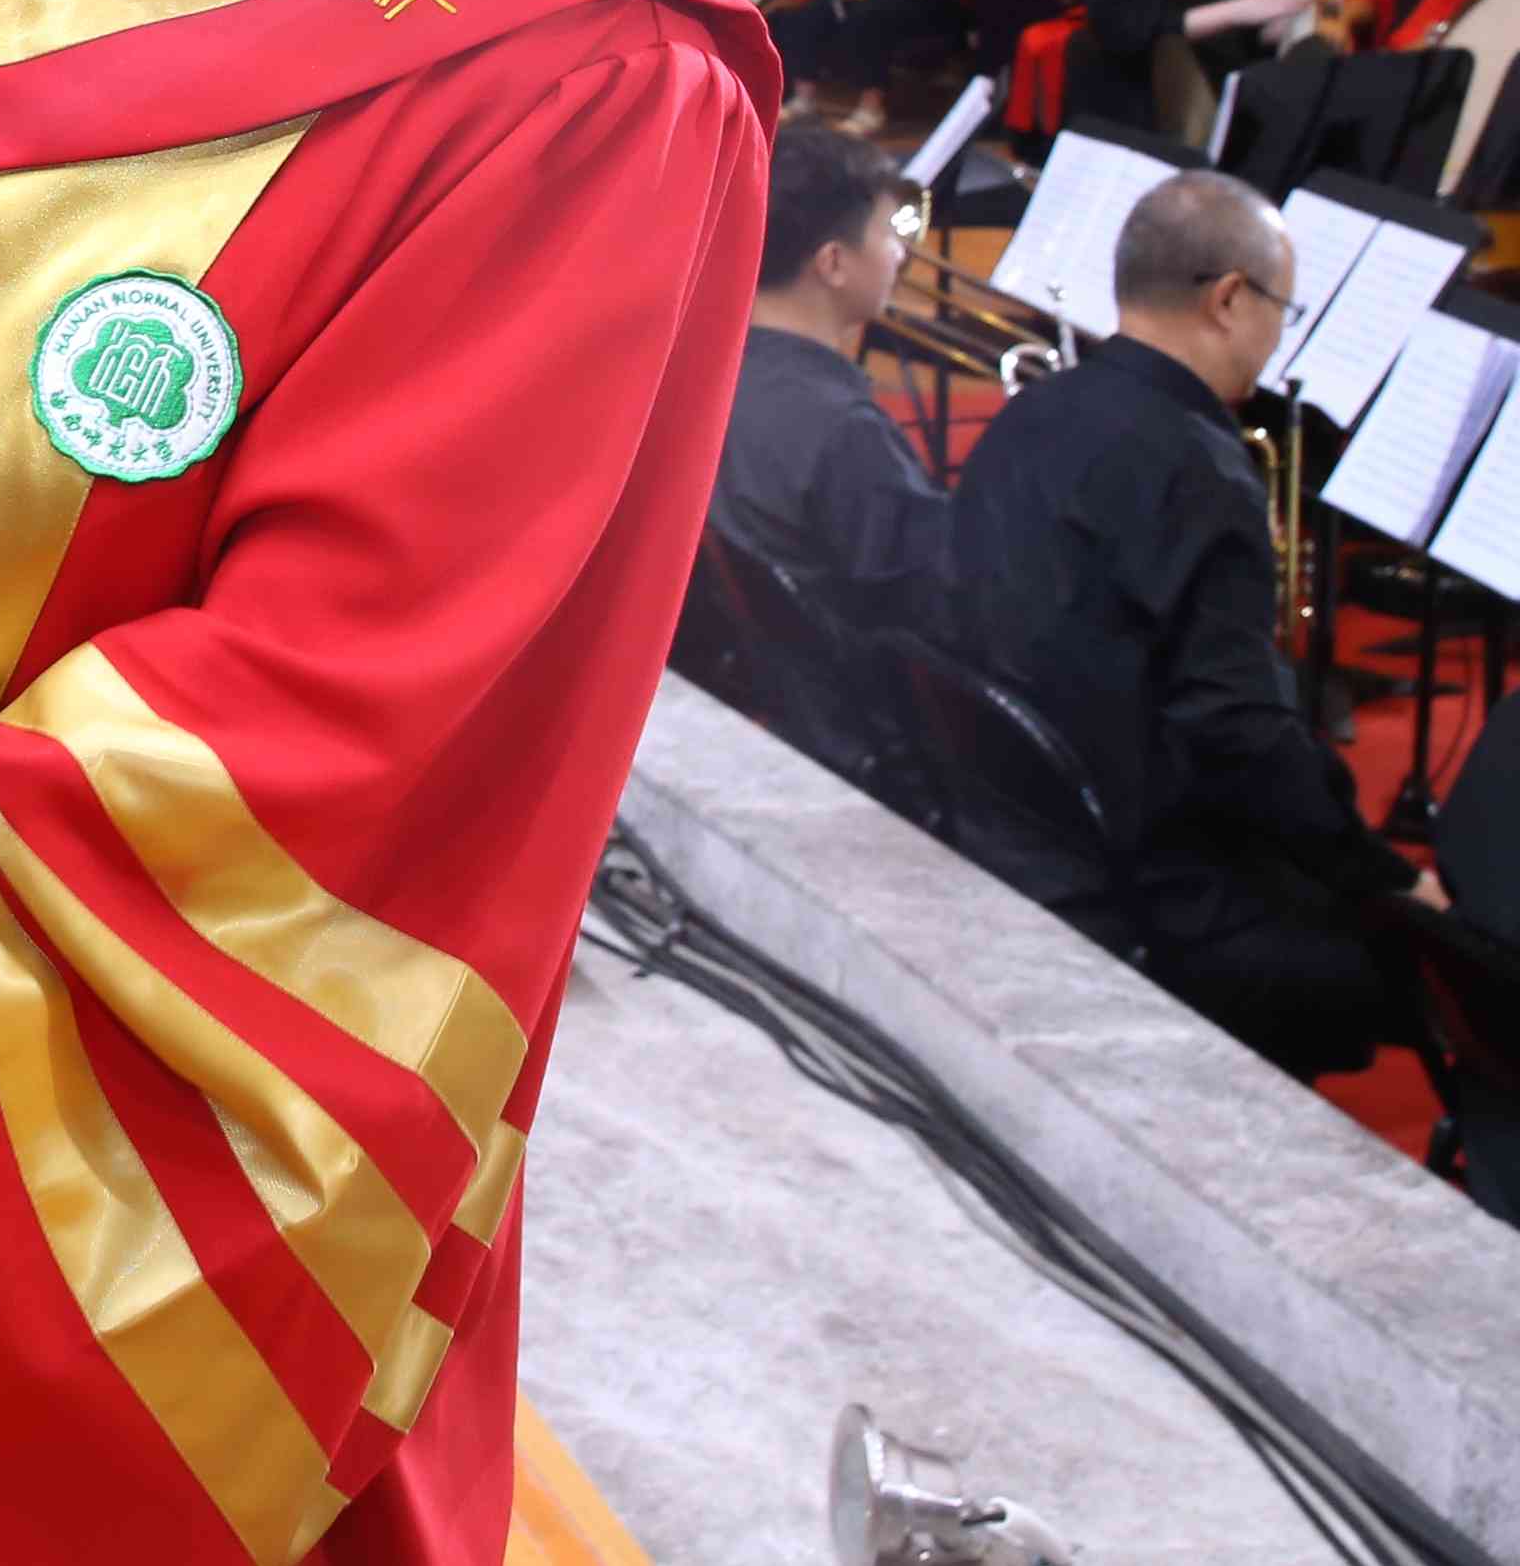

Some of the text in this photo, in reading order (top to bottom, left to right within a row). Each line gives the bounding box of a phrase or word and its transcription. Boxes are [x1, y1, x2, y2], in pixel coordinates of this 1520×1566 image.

[54, 290, 222, 424] HAINAN NORMAL UNIVERSITY
